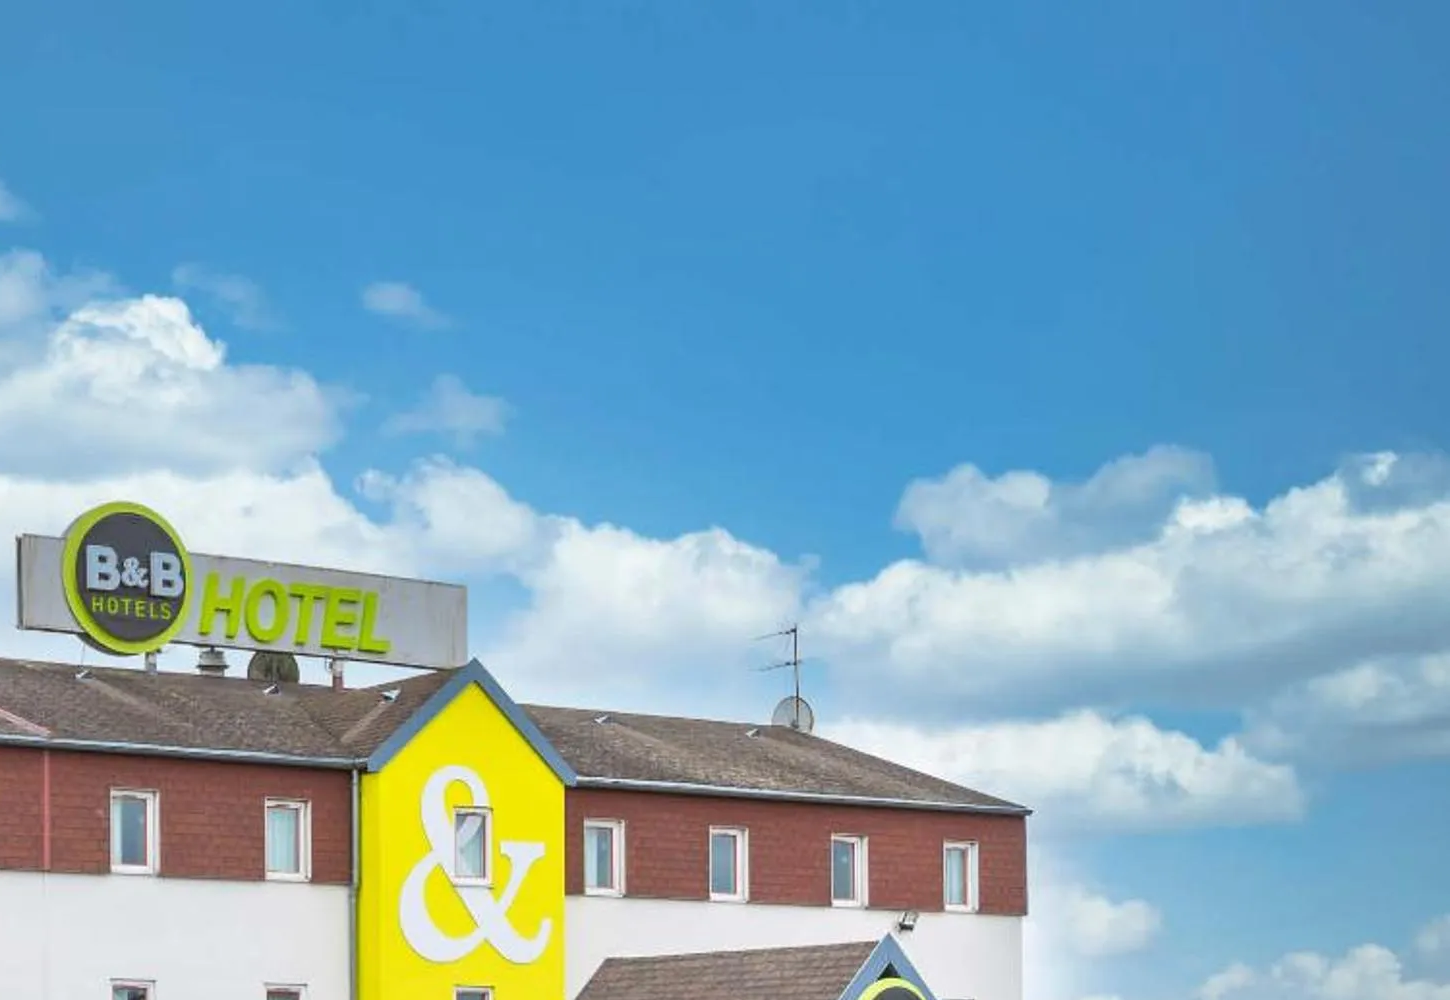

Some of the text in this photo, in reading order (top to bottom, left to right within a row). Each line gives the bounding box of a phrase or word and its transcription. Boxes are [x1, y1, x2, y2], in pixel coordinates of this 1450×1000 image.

[86, 544, 184, 597] B&B
[91, 596, 171, 620] HOTELS
[198, 571, 390, 654] HOTEL
[399, 765, 553, 964] &
